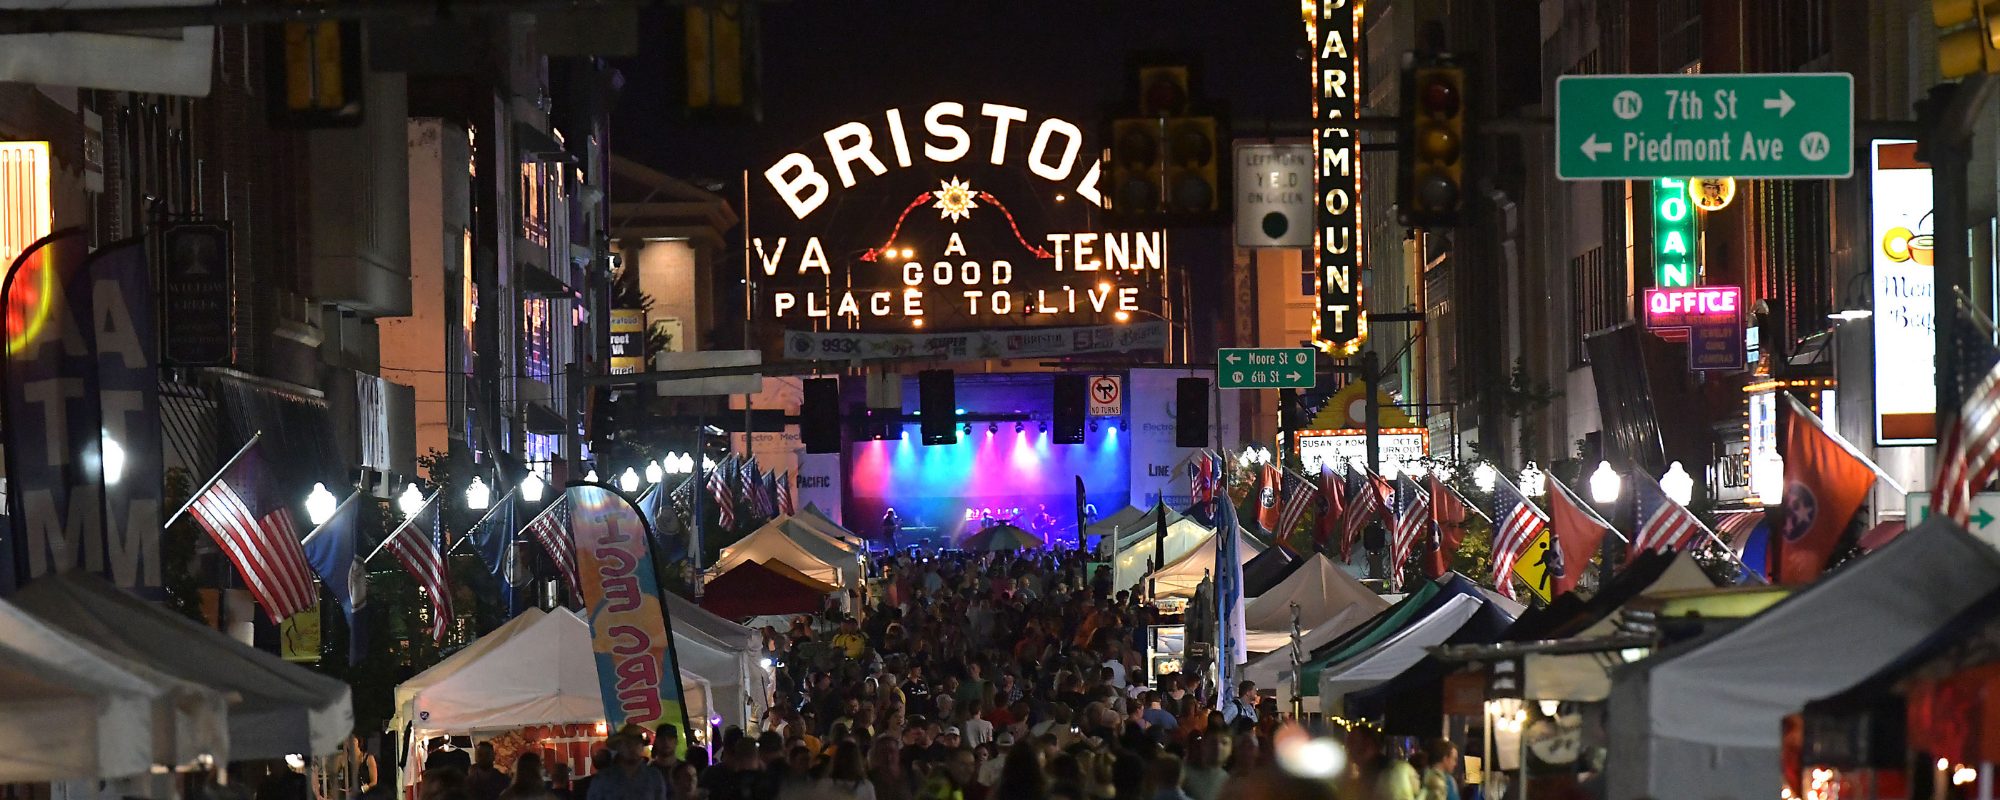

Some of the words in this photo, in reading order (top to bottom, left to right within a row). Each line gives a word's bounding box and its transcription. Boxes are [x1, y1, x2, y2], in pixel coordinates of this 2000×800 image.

[1617, 95, 1639, 114] TN
[1665, 89, 1703, 120] 7th
[1713, 89, 1738, 120] St
[1623, 131, 1732, 163] Piedmont
[1740, 131, 1784, 162] Ave
[1804, 137, 1828, 156] VA
[944, 232, 968, 257] A
[1046, 231, 1161, 271] TENN
[752, 236, 831, 276] VA
[903, 260, 1012, 286] GOOD
[775, 290, 923, 318] PLACE
[964, 290, 1012, 316] TO
[1039, 287, 1140, 314] LIVE
[1650, 291, 1738, 314] OFFICE
[1248, 352, 1276, 365] Moore
[1278, 352, 1289, 365] St
[1251, 370, 1267, 383] 6th
[1270, 370, 1280, 383] St
[1091, 406, 1100, 414] NO
[1101, 406, 1119, 414] TURNS
[741, 434, 774, 442] Eectro
[1302, 439, 1332, 448] SUSAN
[1335, 439, 1342, 447] G
[1413, 437, 1420, 446] 6
[1402, 445, 1421, 453] OUT
[1148, 463, 1170, 477] LINE
[796, 475, 830, 488] PACIFIC
